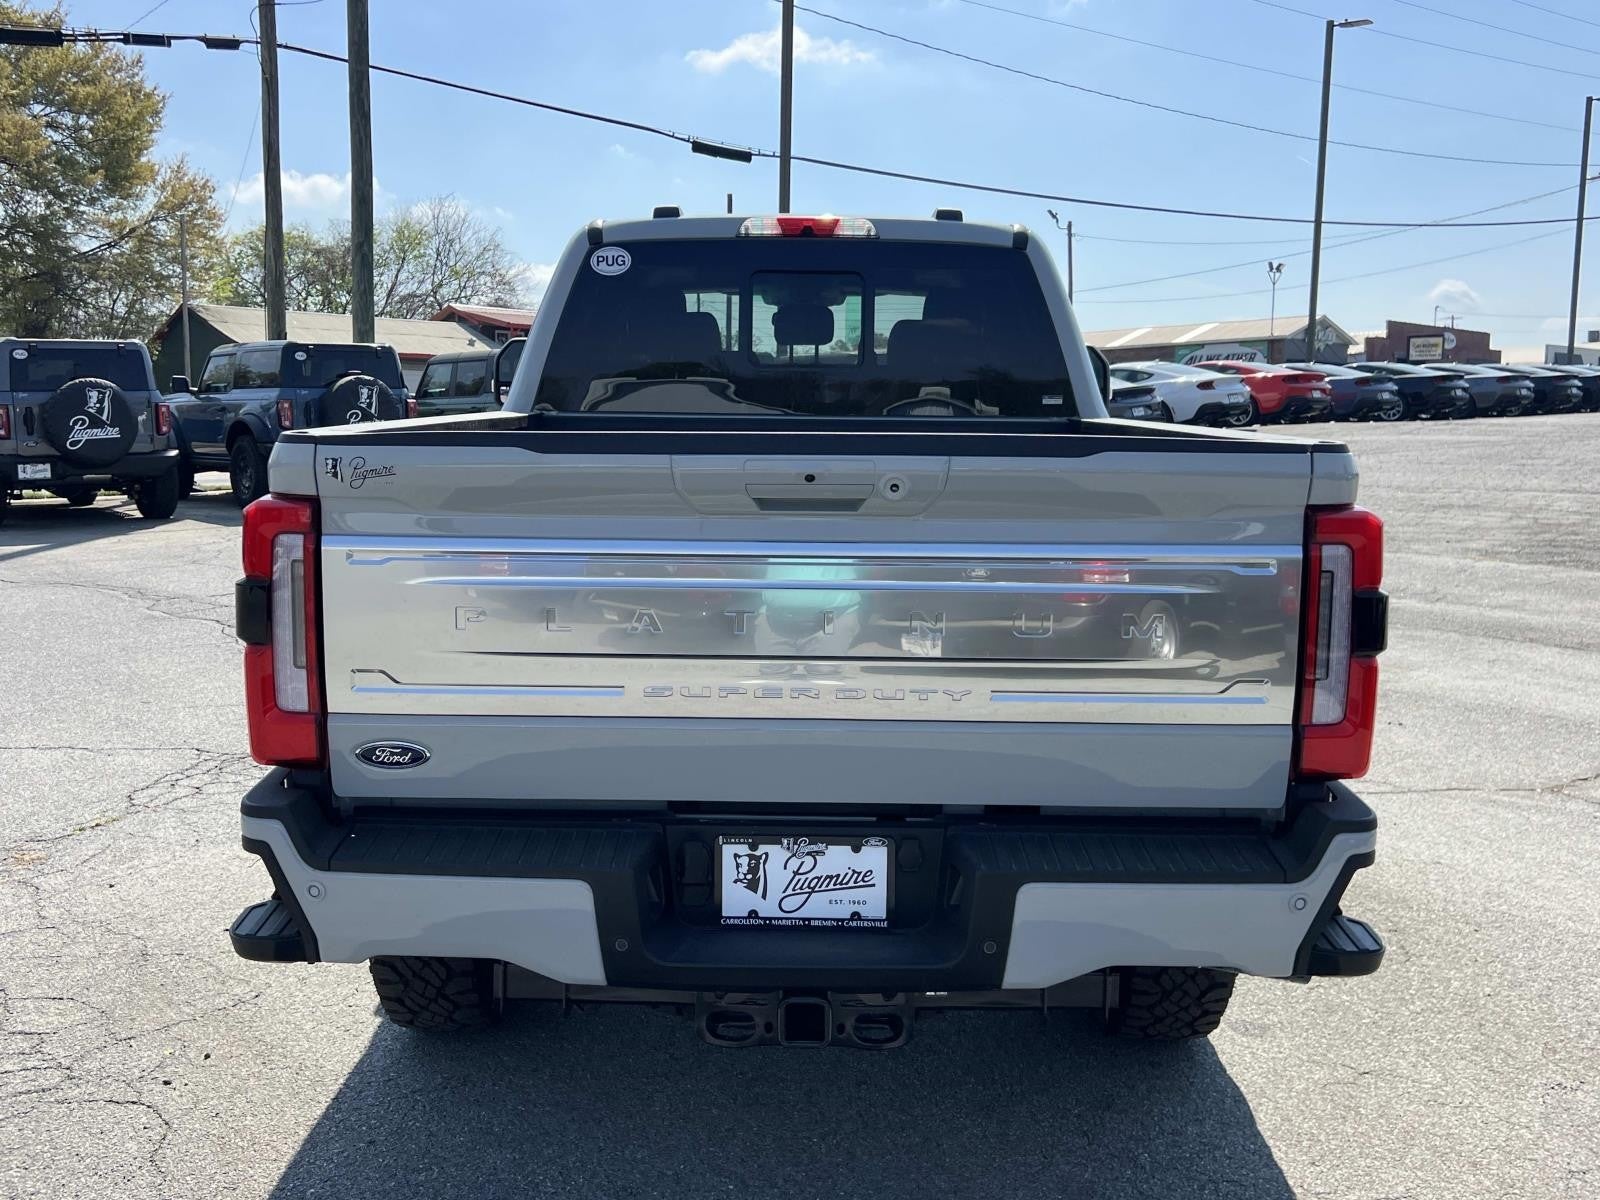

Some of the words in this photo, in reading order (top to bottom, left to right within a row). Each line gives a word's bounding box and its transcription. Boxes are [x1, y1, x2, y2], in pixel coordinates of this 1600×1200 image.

[596, 254, 626, 267] PUG
[1206, 351, 1257, 363] WEATHER
[66, 415, 121, 450] Pugmire
[348, 456, 397, 489] Pugmire
[454, 605, 1166, 641] PLATINUM
[643, 685, 820, 699] SUPER
[835, 687, 973, 701] DUTY
[372, 747, 413, 763] Ford
[778, 854, 876, 914] Pugmire
[720, 917, 764, 926] CARROLLTON
[771, 919, 804, 927] MARIETTA
[810, 920, 837, 928] BREMEN
[843, 920, 888, 929] CARTERSVILLE
